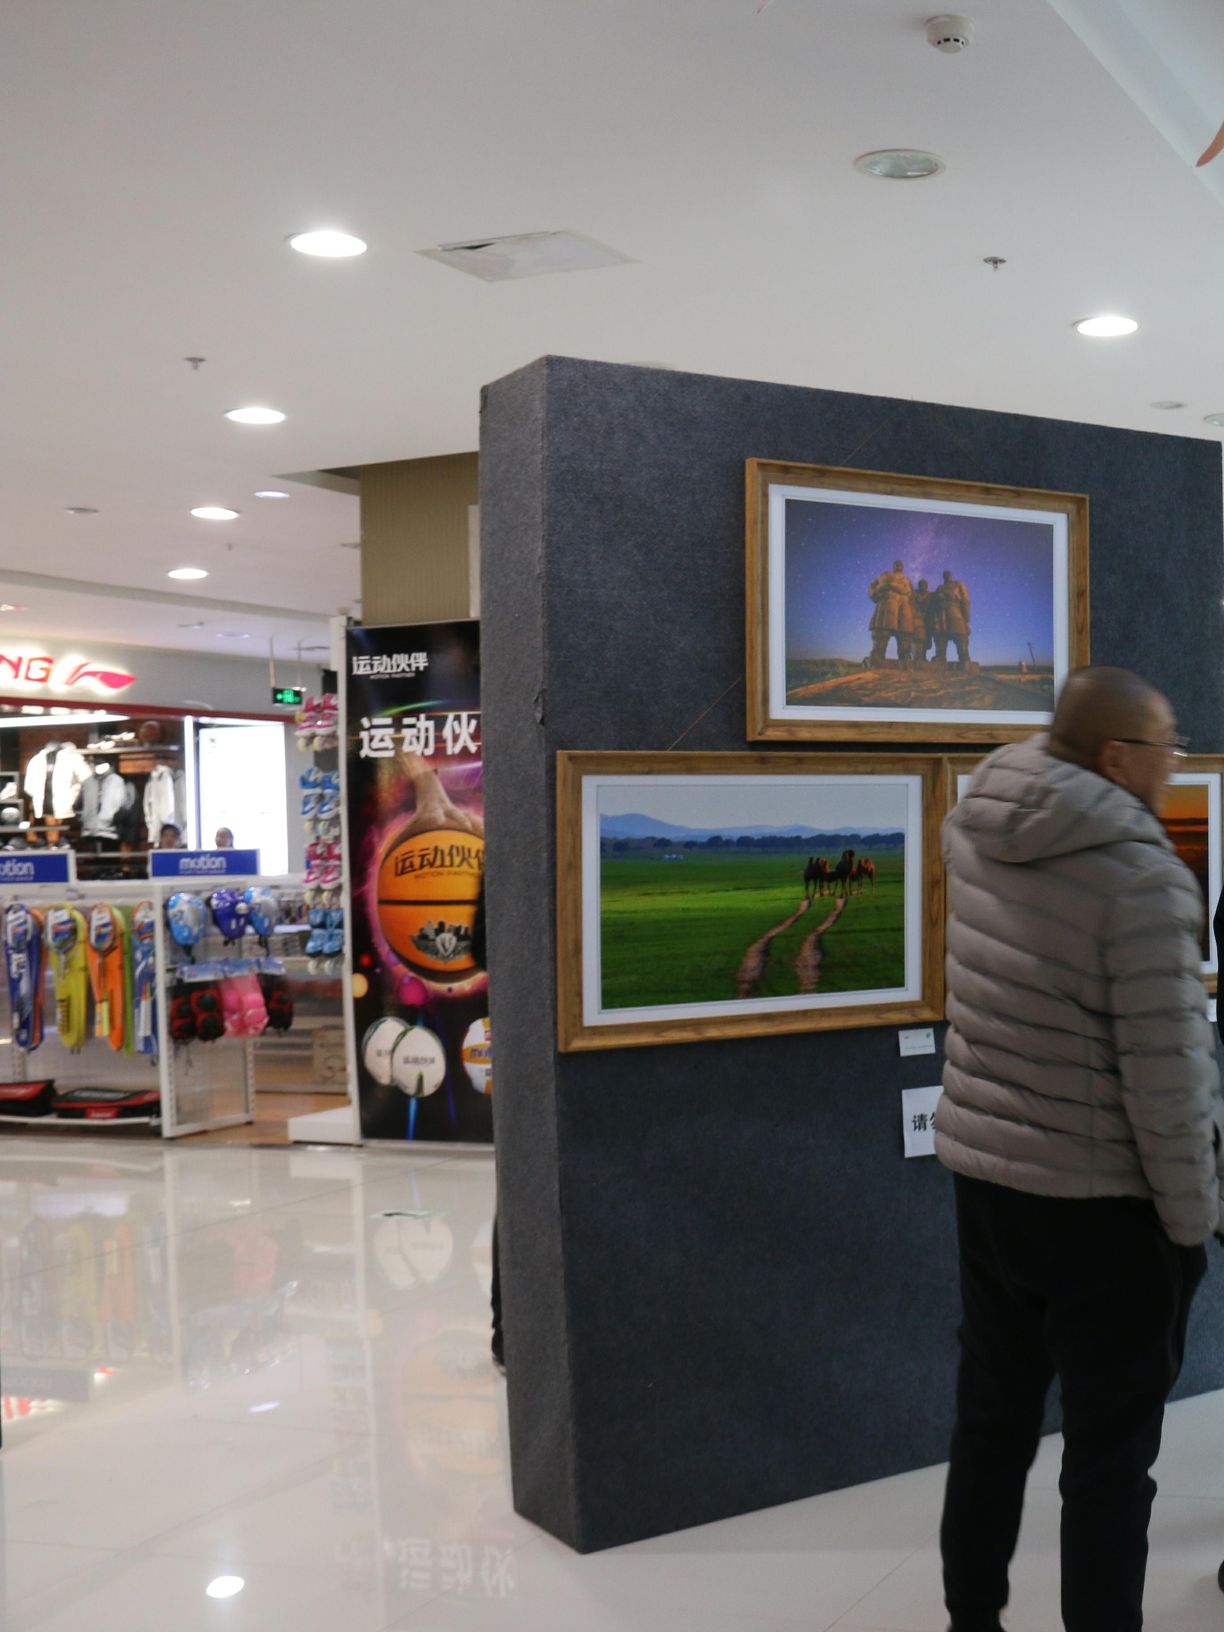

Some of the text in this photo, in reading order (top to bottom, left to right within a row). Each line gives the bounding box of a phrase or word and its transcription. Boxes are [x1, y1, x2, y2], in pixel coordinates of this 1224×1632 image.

[352, 652, 429, 675] 运动伙伴
[360, 712, 478, 759] 运动伙
[179, 854, 227, 870] motion
